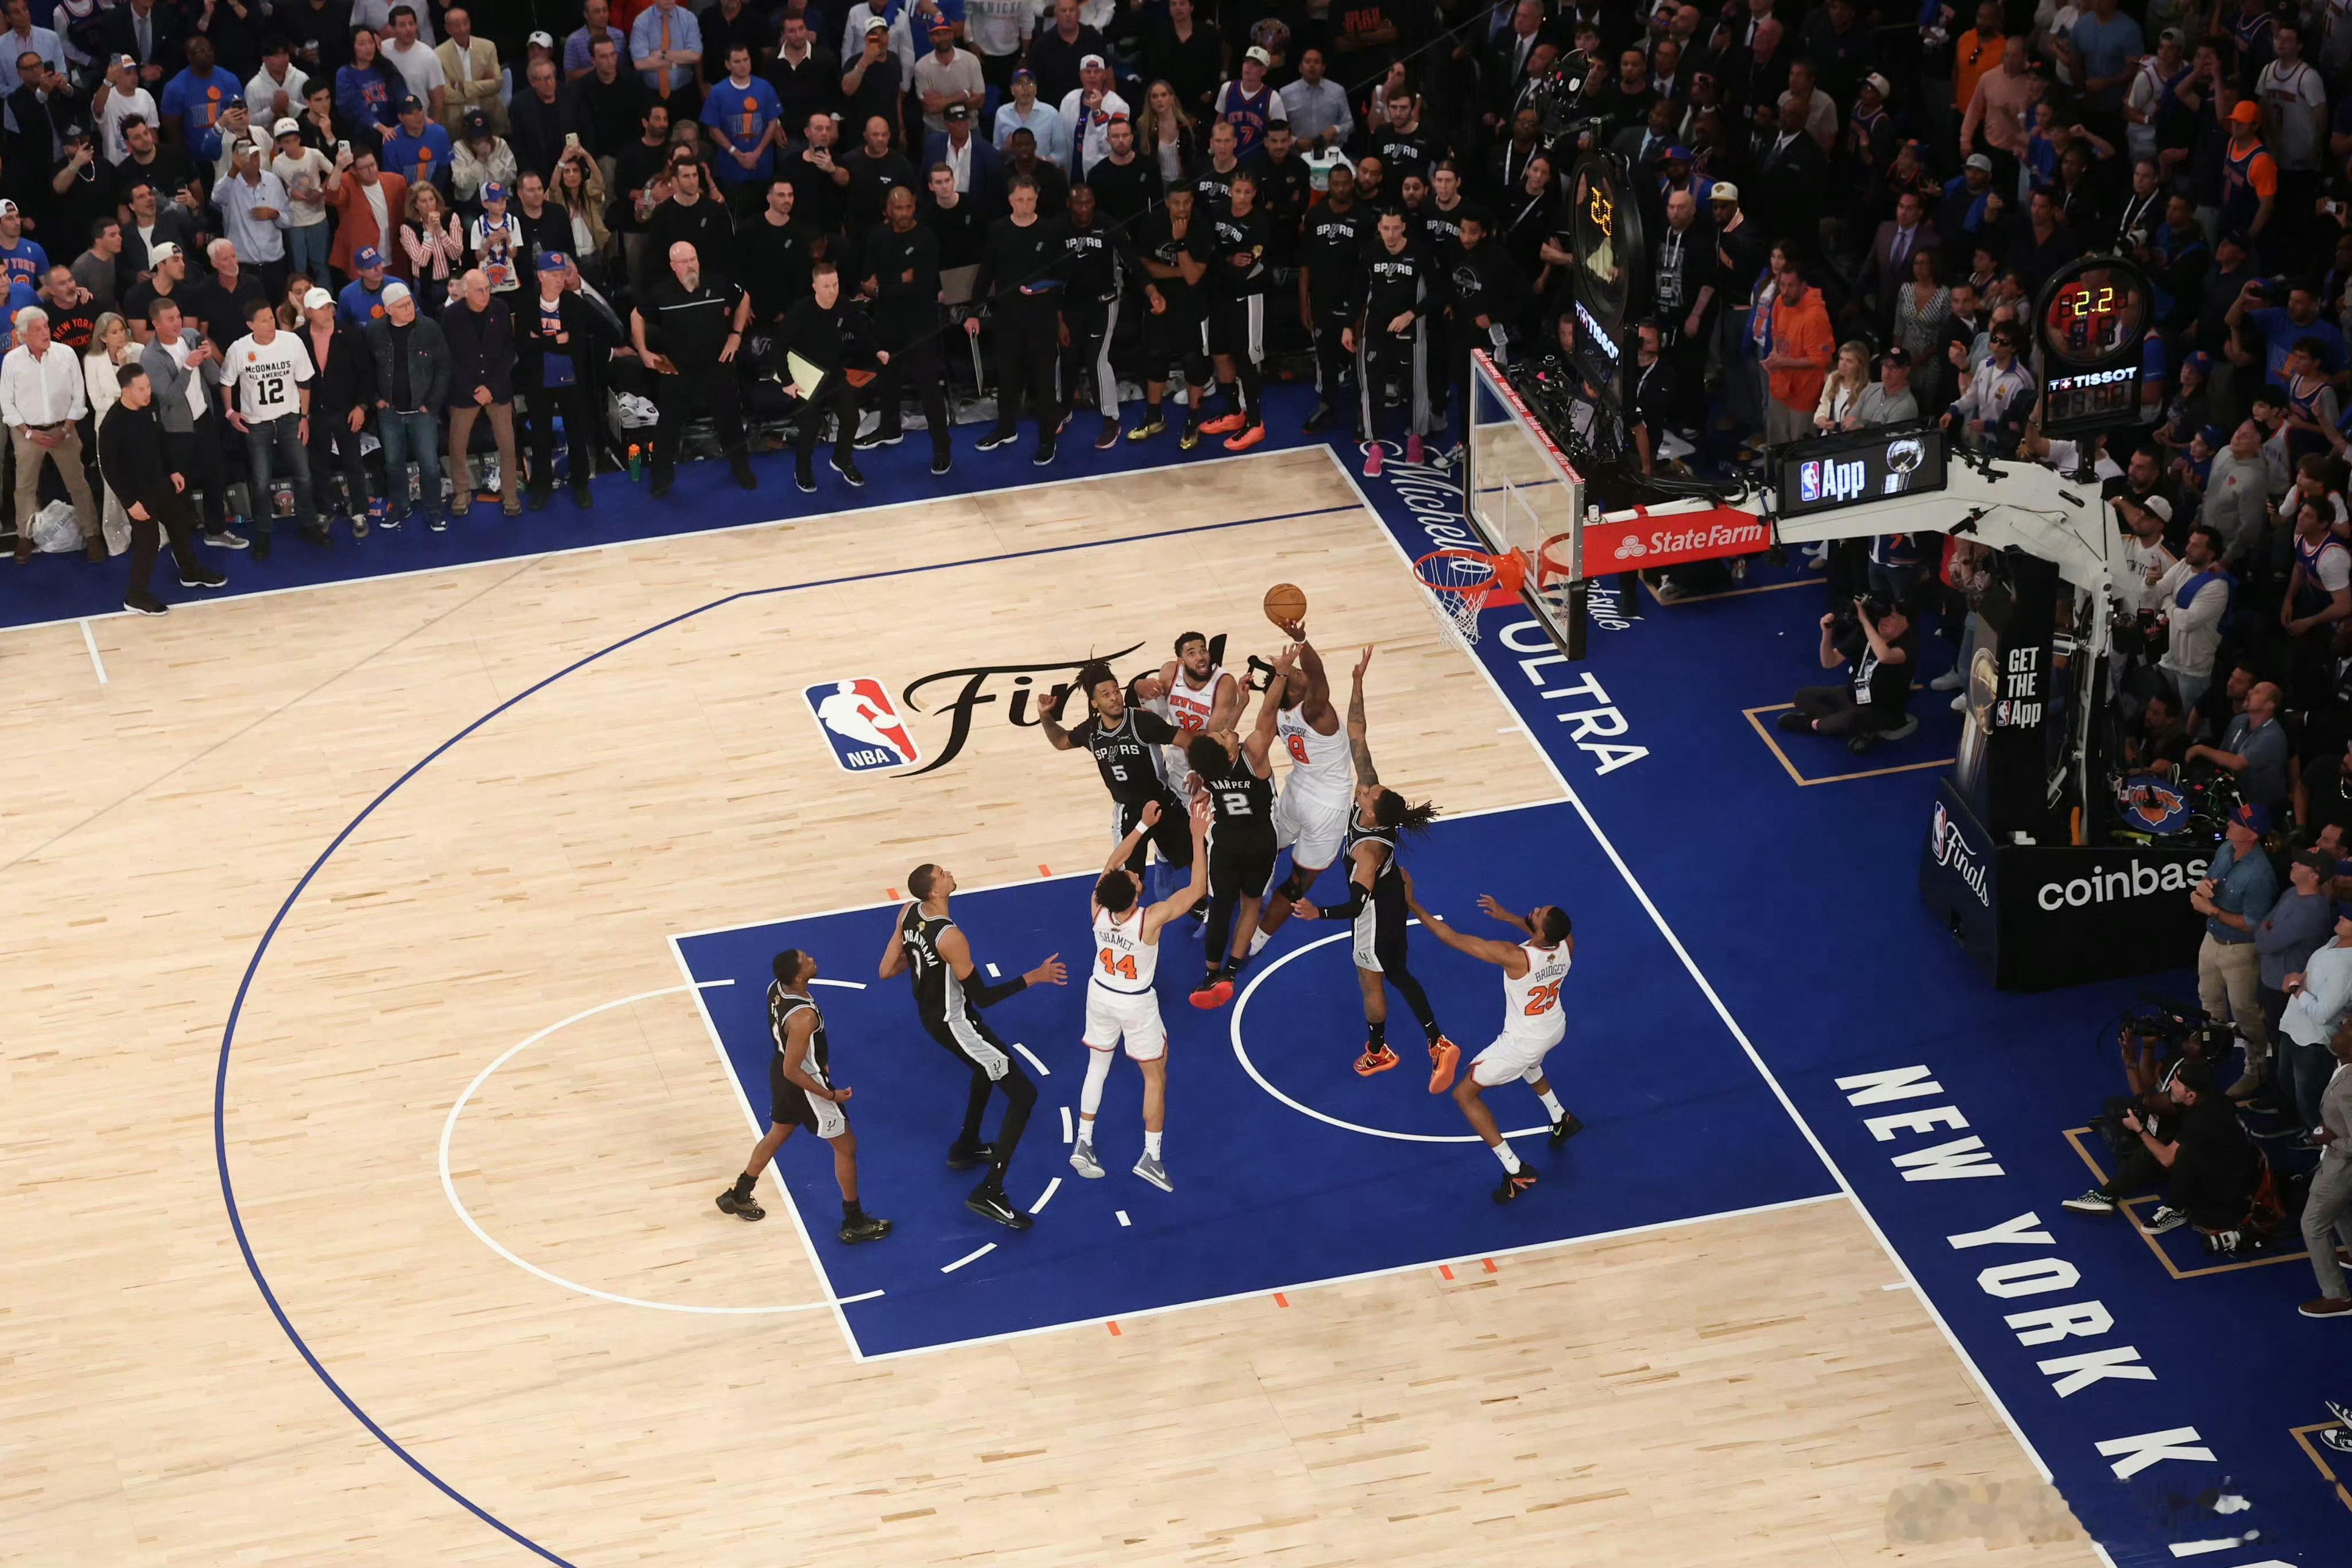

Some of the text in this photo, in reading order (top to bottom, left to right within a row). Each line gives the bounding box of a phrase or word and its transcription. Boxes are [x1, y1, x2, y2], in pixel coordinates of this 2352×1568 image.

[1240, 126, 1254, 144] 7
[1383, 144, 1418, 158] SPURS
[1199, 181, 1232, 197] SPUR
[1214, 222, 1243, 242] SPURS
[1317, 223, 1354, 238] SPURS
[1427, 220, 1460, 237] SPURS
[1374, 262, 1413, 277] SPURS
[2075, 287, 2113, 316] 2.2
[52, 322, 71, 339] NEW
[245, 361, 291, 373] McDONALD'S
[262, 370, 290, 380] AMERICAN
[2074, 366, 2137, 388] TISSOT
[257, 378, 284, 405] 12
[1821, 459, 1865, 501] App
[2009, 646, 2040, 673] GET
[2007, 672, 2038, 698] THE
[1170, 695, 1211, 717] NEW YORK
[1499, 620, 1650, 776] ULTRA
[1175, 710, 1205, 731] 32
[2010, 700, 2041, 729] App
[849, 748, 890, 768] NBA
[1094, 745, 1140, 763] SPURS
[1288, 734, 1310, 764] 8
[1111, 765, 1128, 781] 5
[1210, 779, 1251, 790] HARPER
[1222, 793, 1253, 816] 2
[1936, 821, 1990, 908] Finals
[2038, 859, 2208, 911] coinbas
[901, 929, 940, 967] MBANYAMA
[1099, 931, 1134, 951] SHAMET
[1099, 947, 1138, 980] 44
[1534, 964, 1566, 982] BRIDGES
[1525, 977, 1564, 1016] 25
[1834, 1064, 2006, 1182] NEW
[1947, 1211, 2158, 1399] YORK
